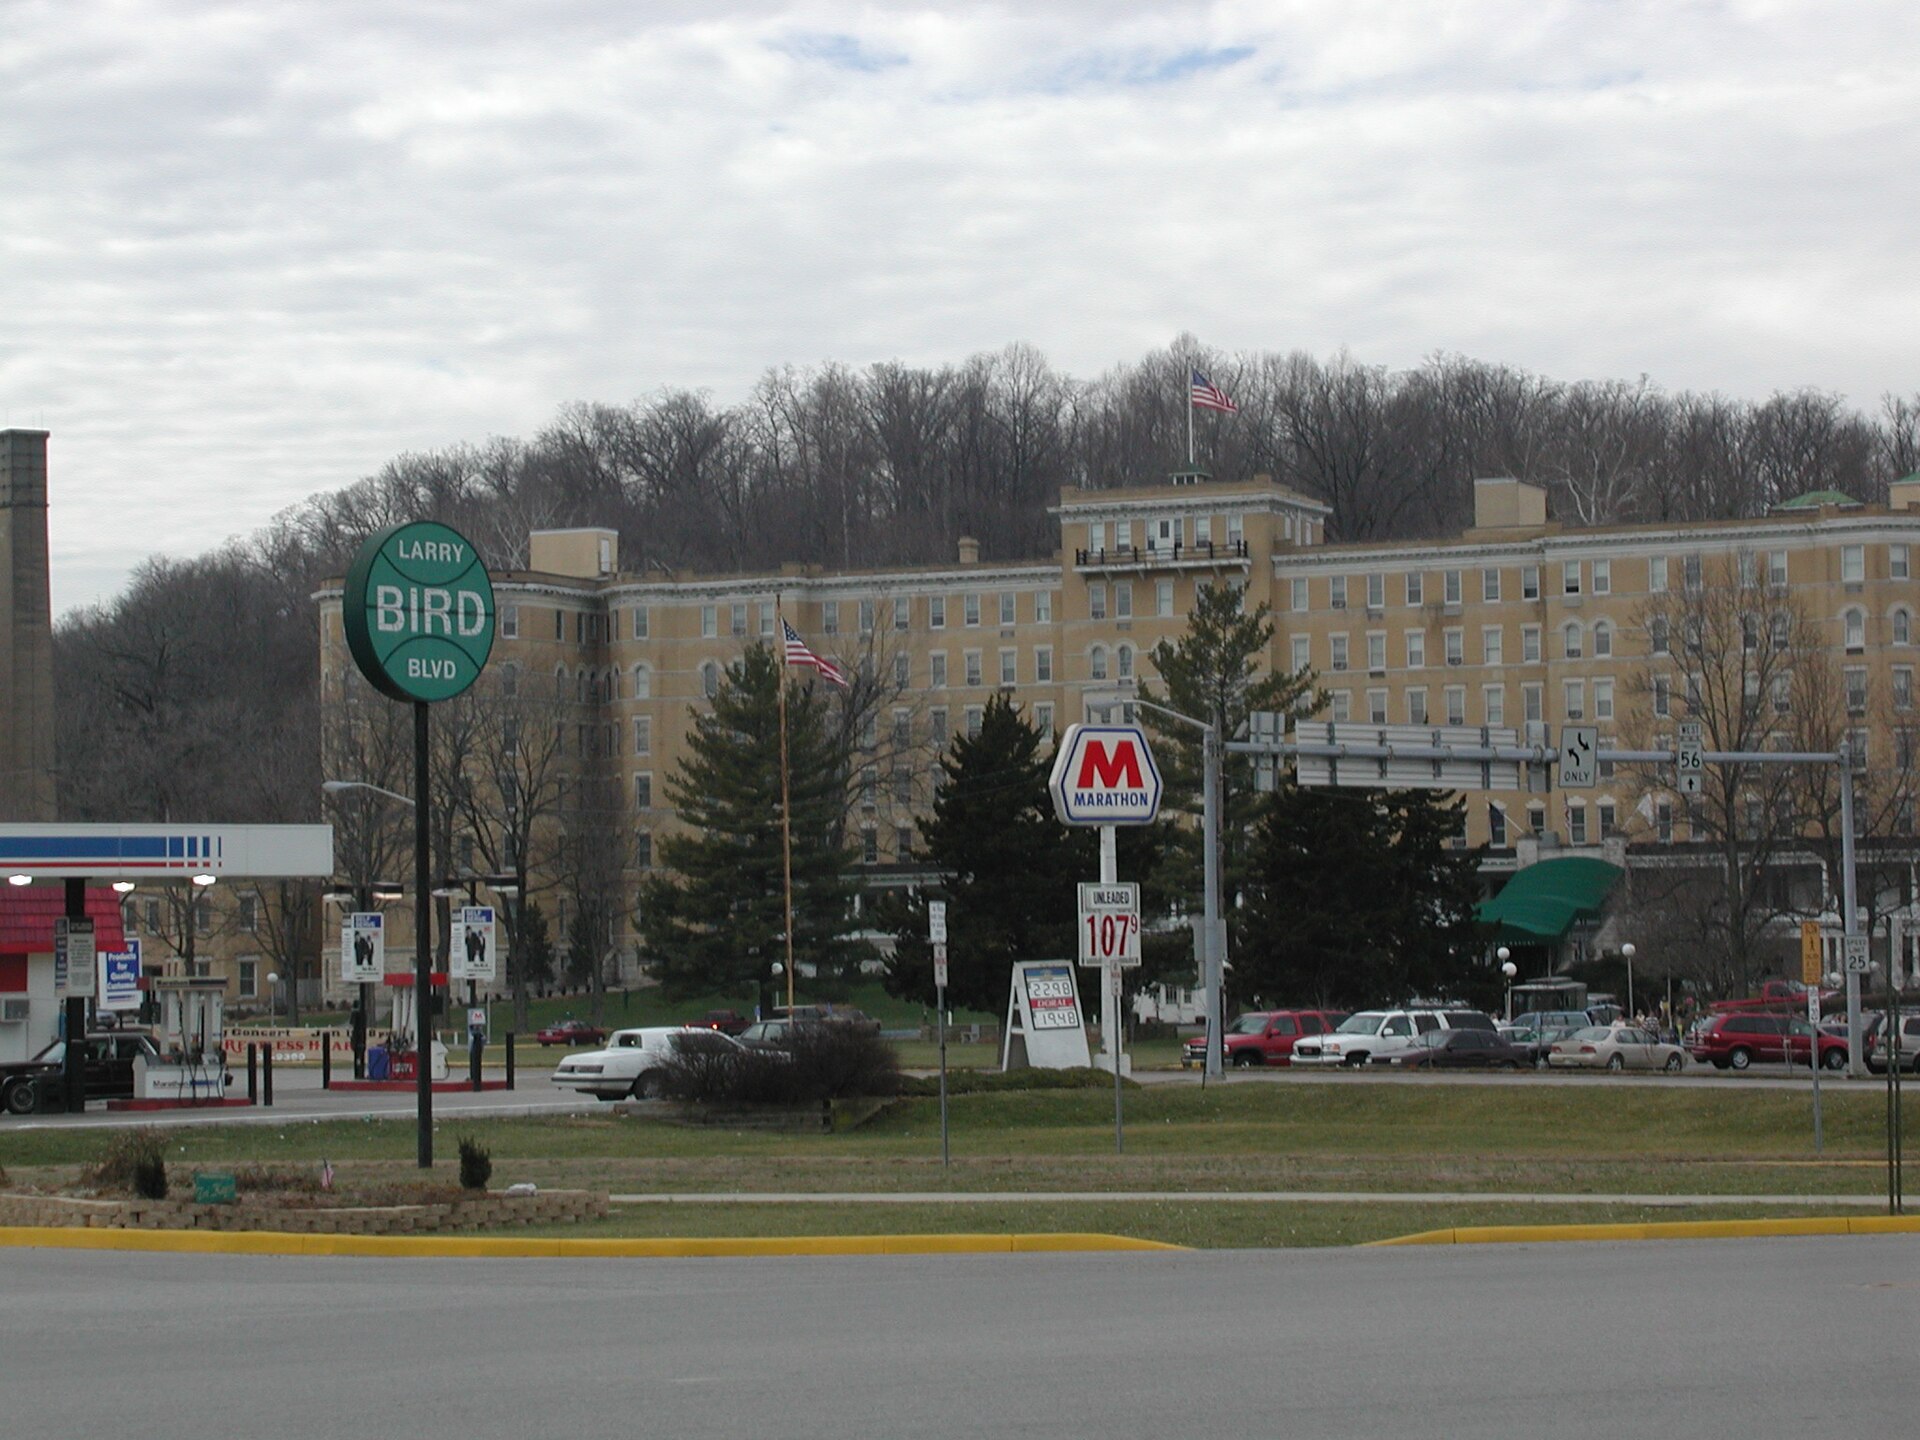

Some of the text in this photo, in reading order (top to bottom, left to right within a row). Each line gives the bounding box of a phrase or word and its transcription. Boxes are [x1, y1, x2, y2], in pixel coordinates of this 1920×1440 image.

[399, 539, 464, 563] LARRY
[376, 585, 486, 636] BIRD
[408, 658, 456, 680] BLVD
[1077, 740, 1144, 788] M
[1681, 751, 1700, 769] 56
[1564, 771, 1590, 782] ONLY
[1074, 792, 1148, 806] MARATHON
[1093, 891, 1130, 904] UNLEADED
[1849, 946, 1865, 954] LIMIT
[1849, 955, 1866, 970] 25
[1037, 998, 1067, 1008] DORAL
[232, 1028, 290, 1038] Concert
[311, 1030, 341, 1038] Jn
